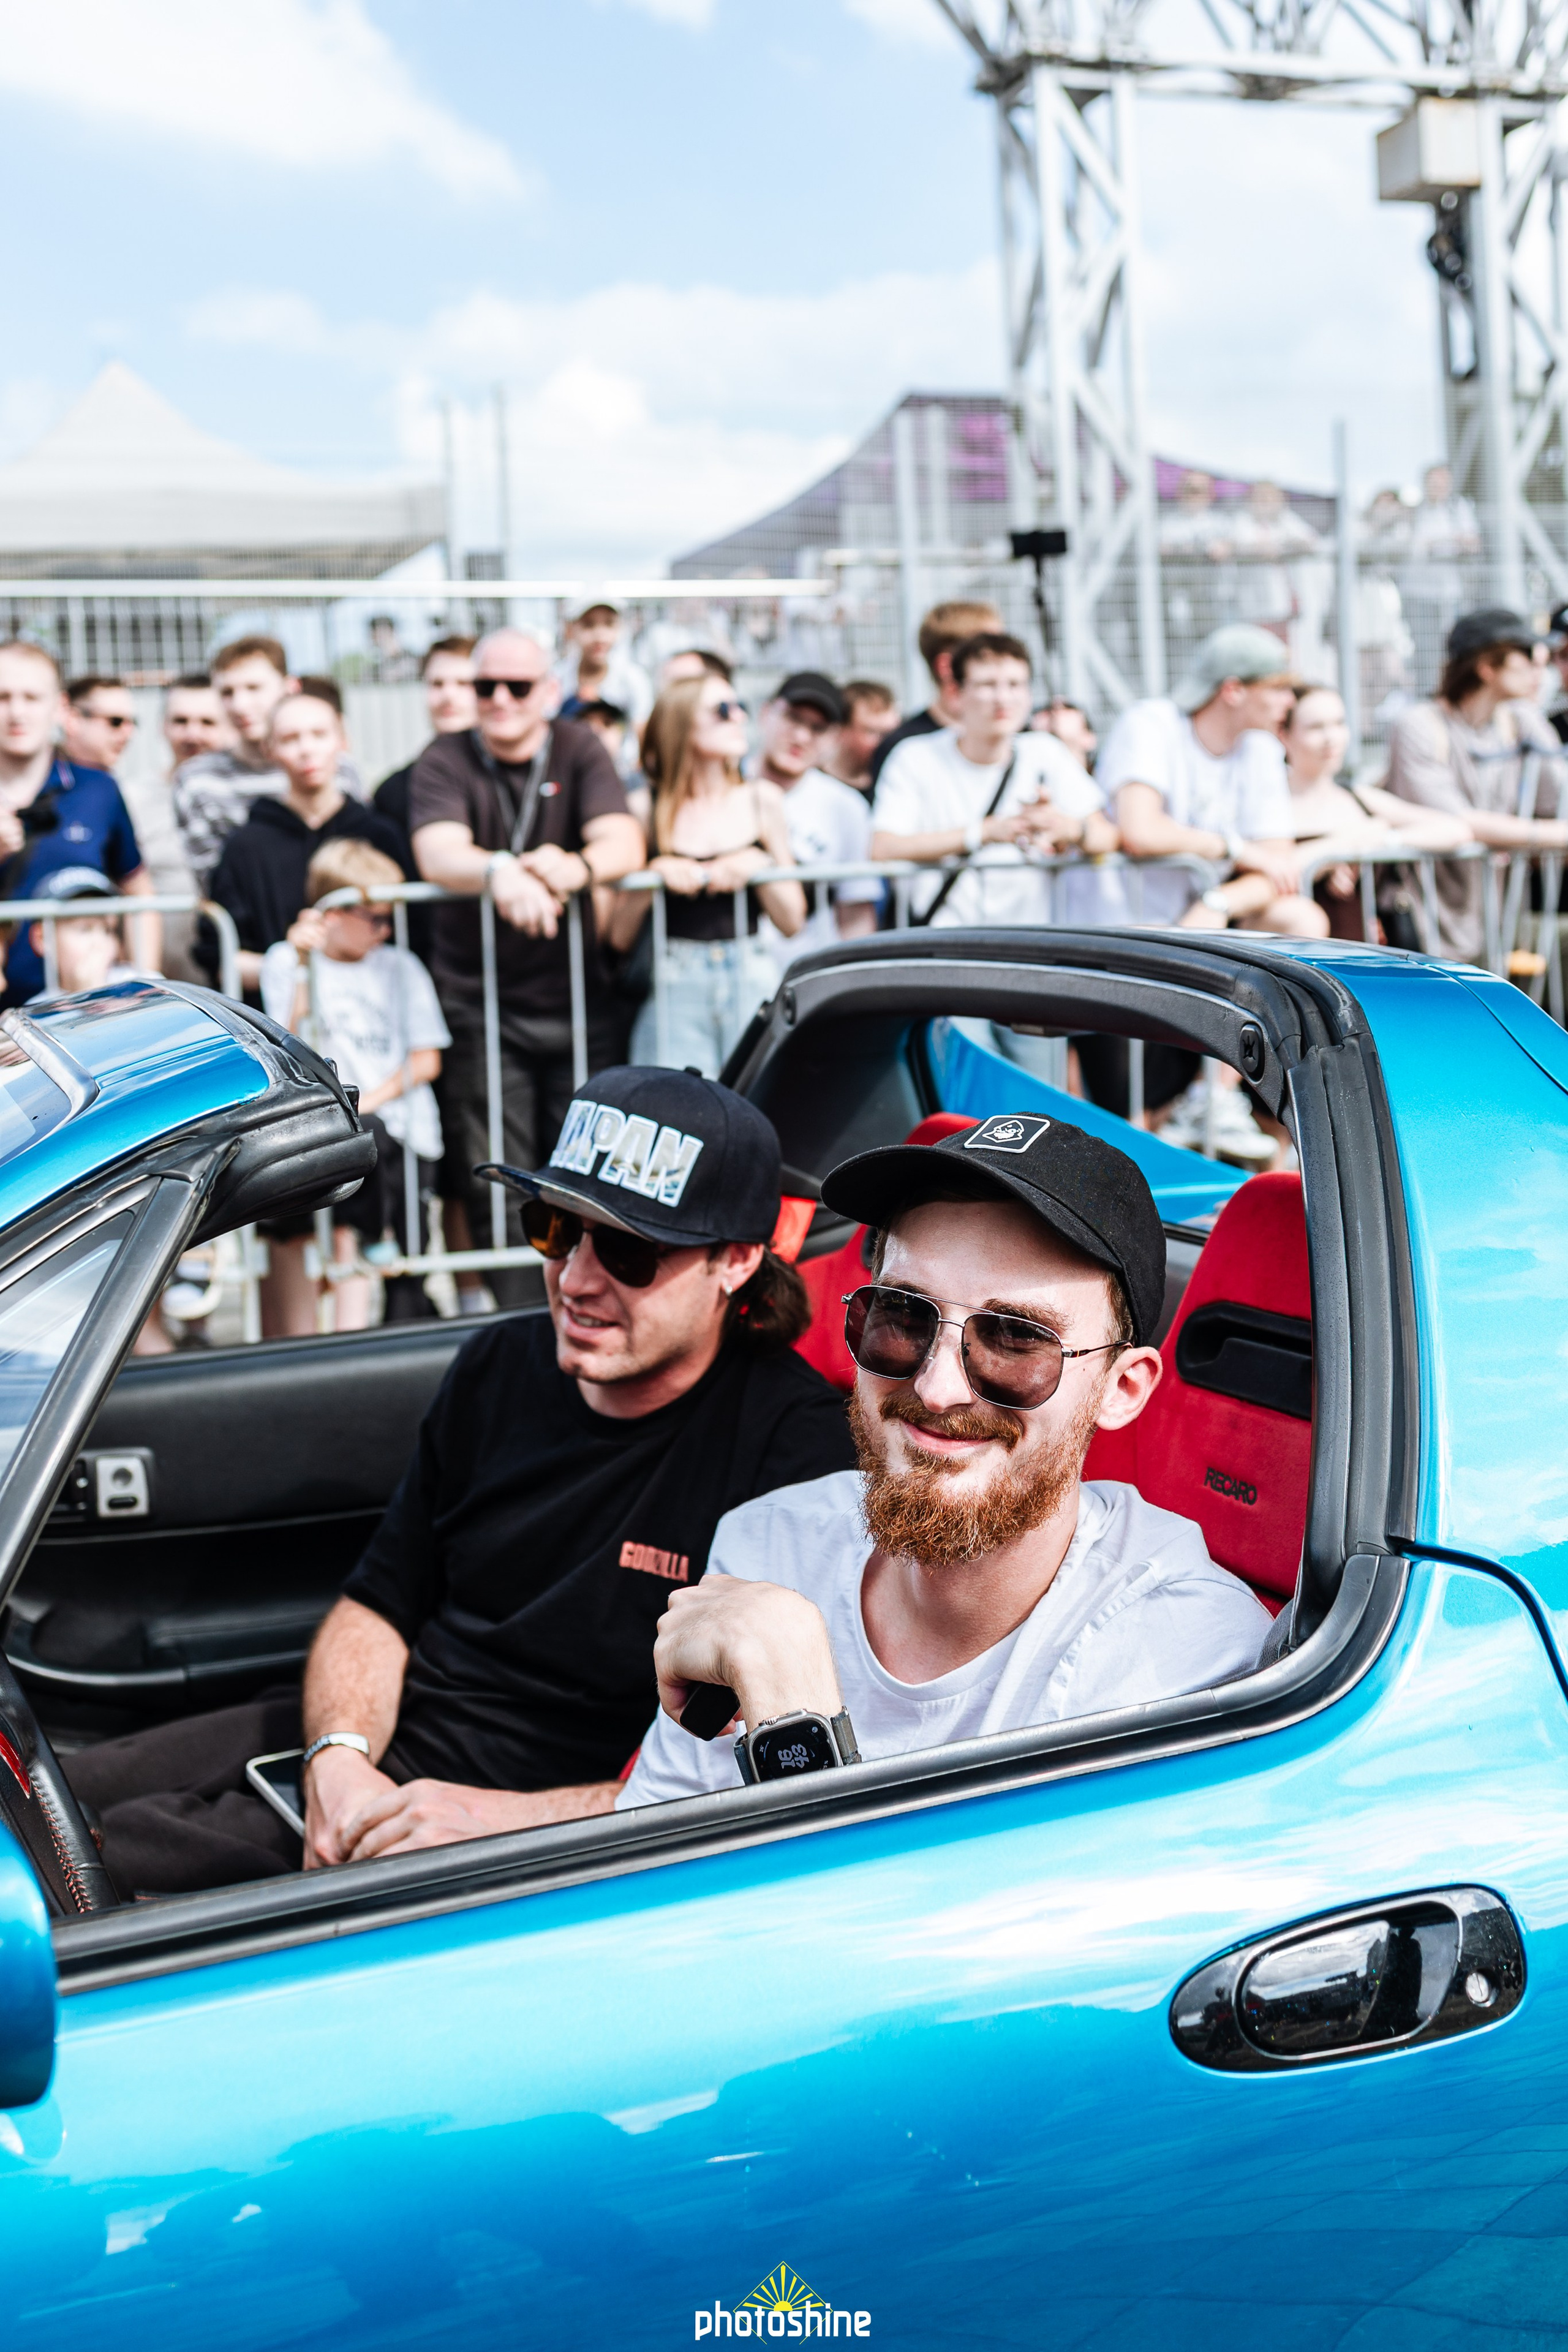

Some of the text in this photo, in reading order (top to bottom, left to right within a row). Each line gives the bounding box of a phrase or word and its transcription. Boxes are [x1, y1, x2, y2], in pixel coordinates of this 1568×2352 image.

[1035, 1327, 1052, 1338] Polaroid
[1204, 1466, 1257, 1506] RECARO
[619, 1540, 690, 1583] GODZILLA
[777, 1749, 793, 1770] 16
[791, 1743, 810, 1769] 43
